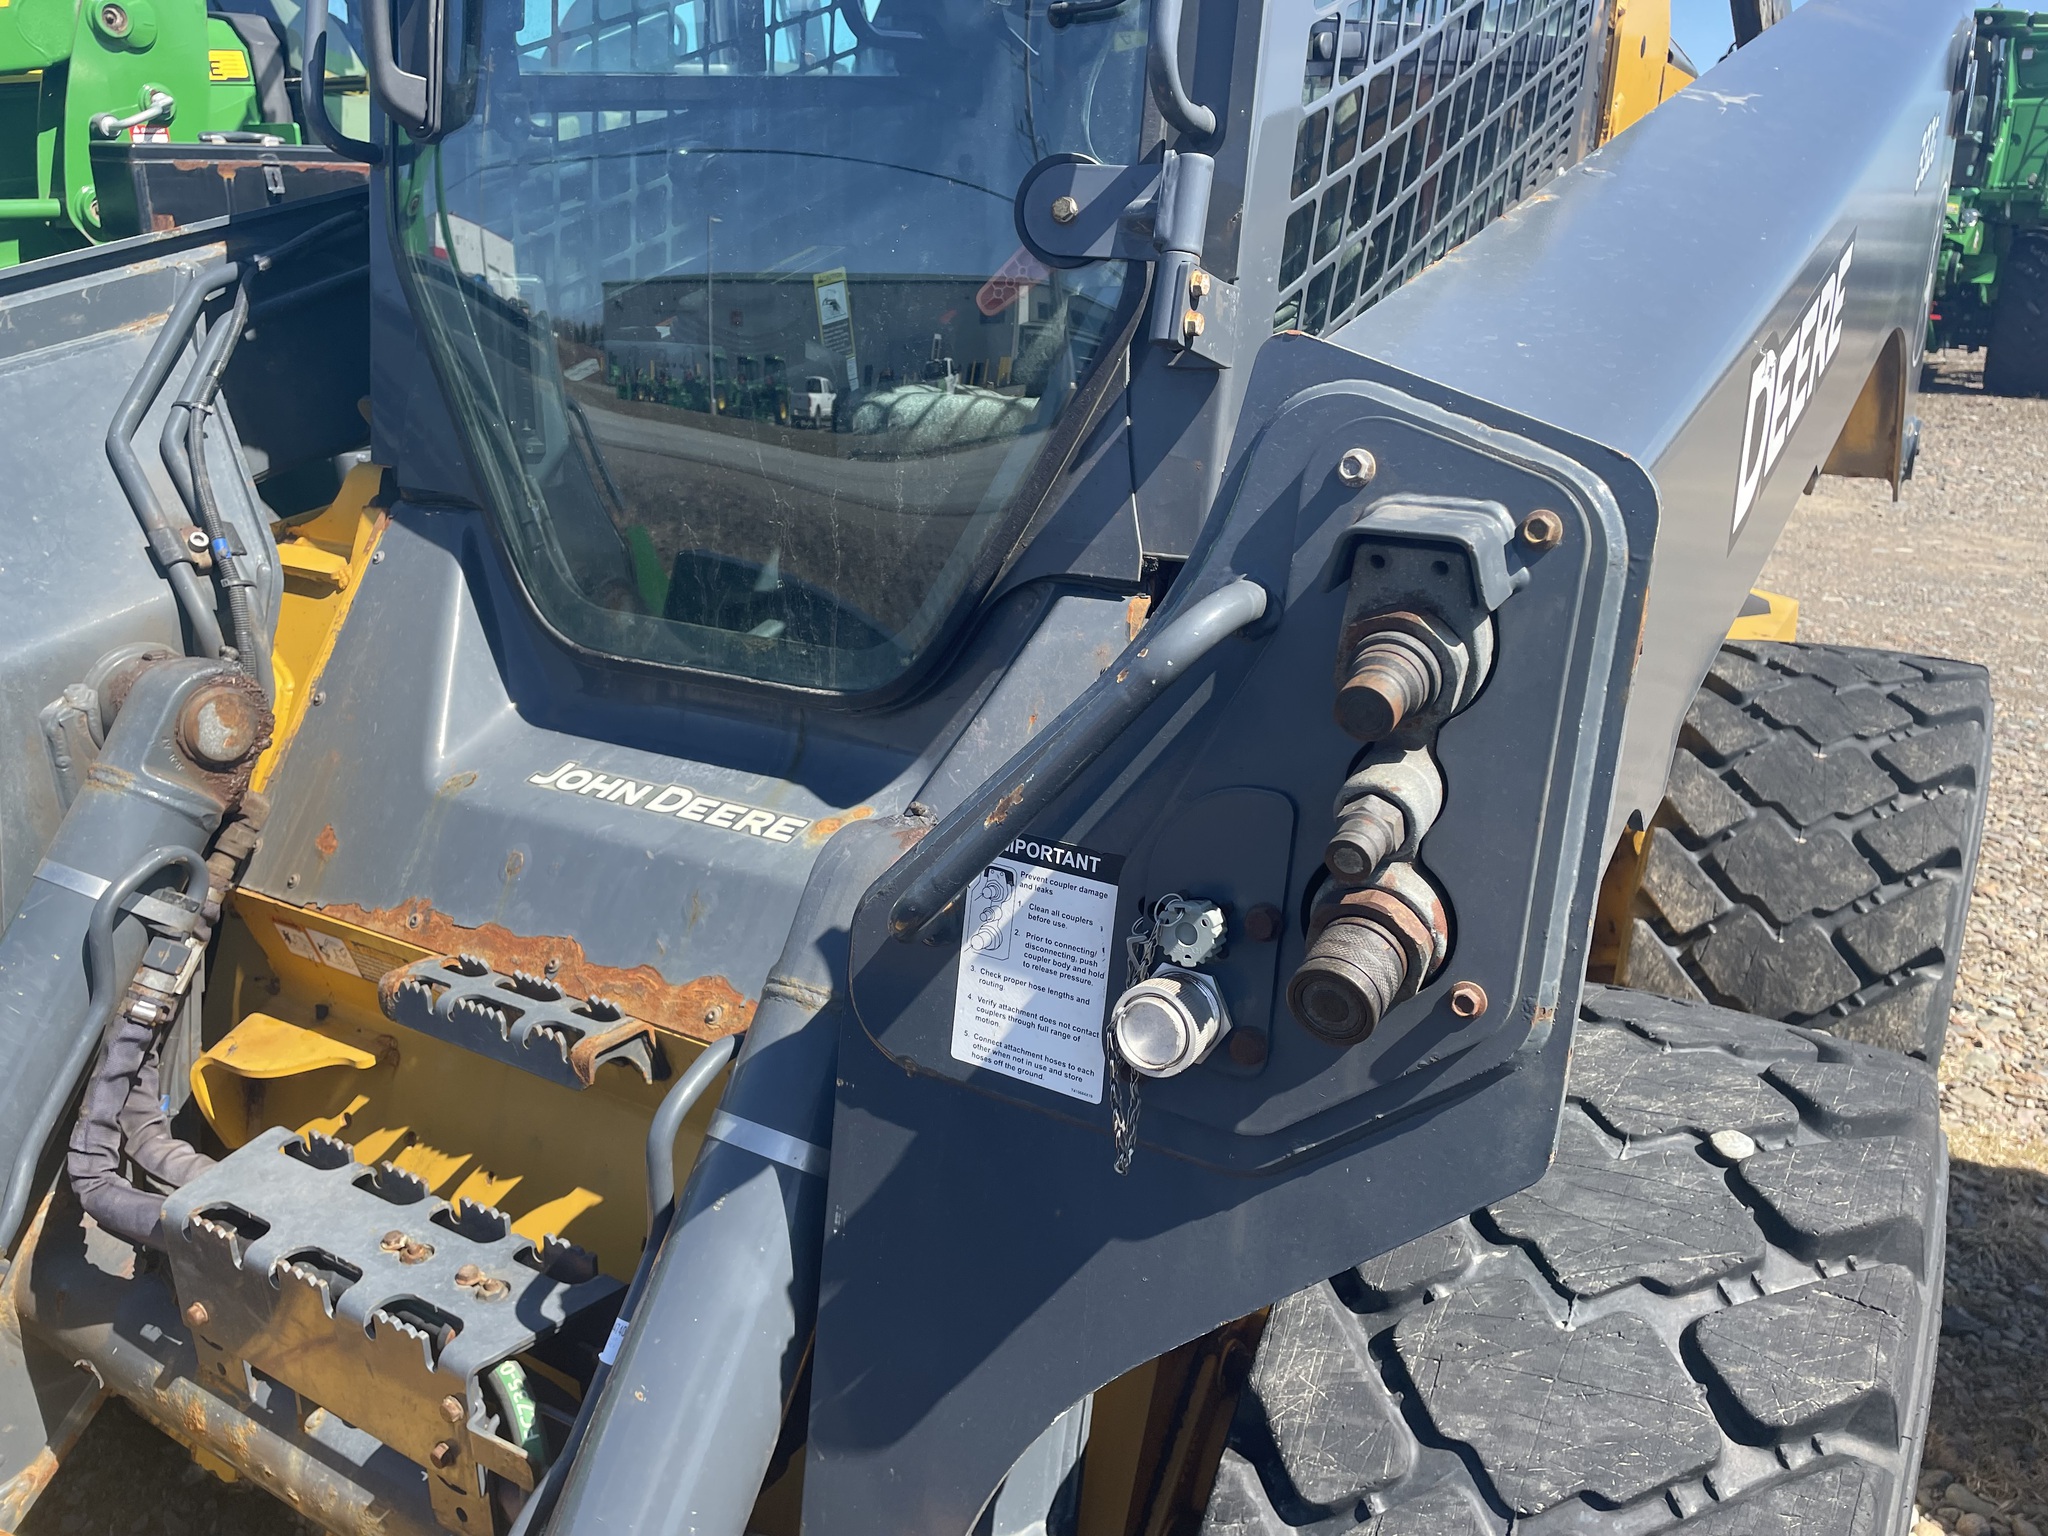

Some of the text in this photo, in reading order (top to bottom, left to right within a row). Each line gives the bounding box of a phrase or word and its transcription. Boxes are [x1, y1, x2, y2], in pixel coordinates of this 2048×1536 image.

[1732, 241, 1854, 534] DEERE
[529, 762, 811, 843] JOHN DEERE
[1005, 838, 1101, 873] PORTANT
[1020, 871, 1108, 900] Prevent coupler damage
[1020, 882, 1053, 896] and leaks
[1028, 912, 1068, 929] before use.
[1029, 903, 1049, 915] Clean
[1051, 908, 1060, 917] all
[1062, 911, 1093, 926] couplers
[1026, 932, 1043, 943] Prior
[1054, 940, 1098, 958] connecting/
[1024, 952, 1104, 979] coupler body and hold
[1032, 963, 1058, 976] release
[1060, 971, 1093, 987] pressure.
[1079, 958, 1098, 968] push
[980, 968, 1001, 980] Check
[1003, 975, 1027, 987] proper
[1029, 980, 1046, 993] hose
[1048, 987, 1074, 1001] lengths
[1076, 996, 1090, 1006] and
[975, 1015, 1000, 1028] motion.
[976, 1005, 1006, 1020] couplers
[1008, 1015, 1035, 1029] through
[1038, 1023, 1049, 1033] full
[1050, 1028, 1071, 1040] range
[978, 996, 997, 1008] Verify
[999, 1002, 1038, 1019] attachment
[1039, 1014, 1057, 1026] does
[1058, 1021, 1071, 1030] not
[1072, 1025, 1099, 1039] contact
[971, 1052, 1044, 1080] hoses off the ground.
[972, 1043, 991, 1054] other
[992, 1048, 1011, 1059] when
[1012, 1055, 1024, 1064] not
[1034, 1062, 1047, 1071] use
[1049, 1065, 1062, 1074] and
[1064, 1071, 1083, 1083] store
[974, 1033, 1002, 1048] Connect
[1004, 1042, 1043, 1061] attachment
[1044, 1055, 1066, 1068] hoses
[1077, 1066, 1095, 1077] each
